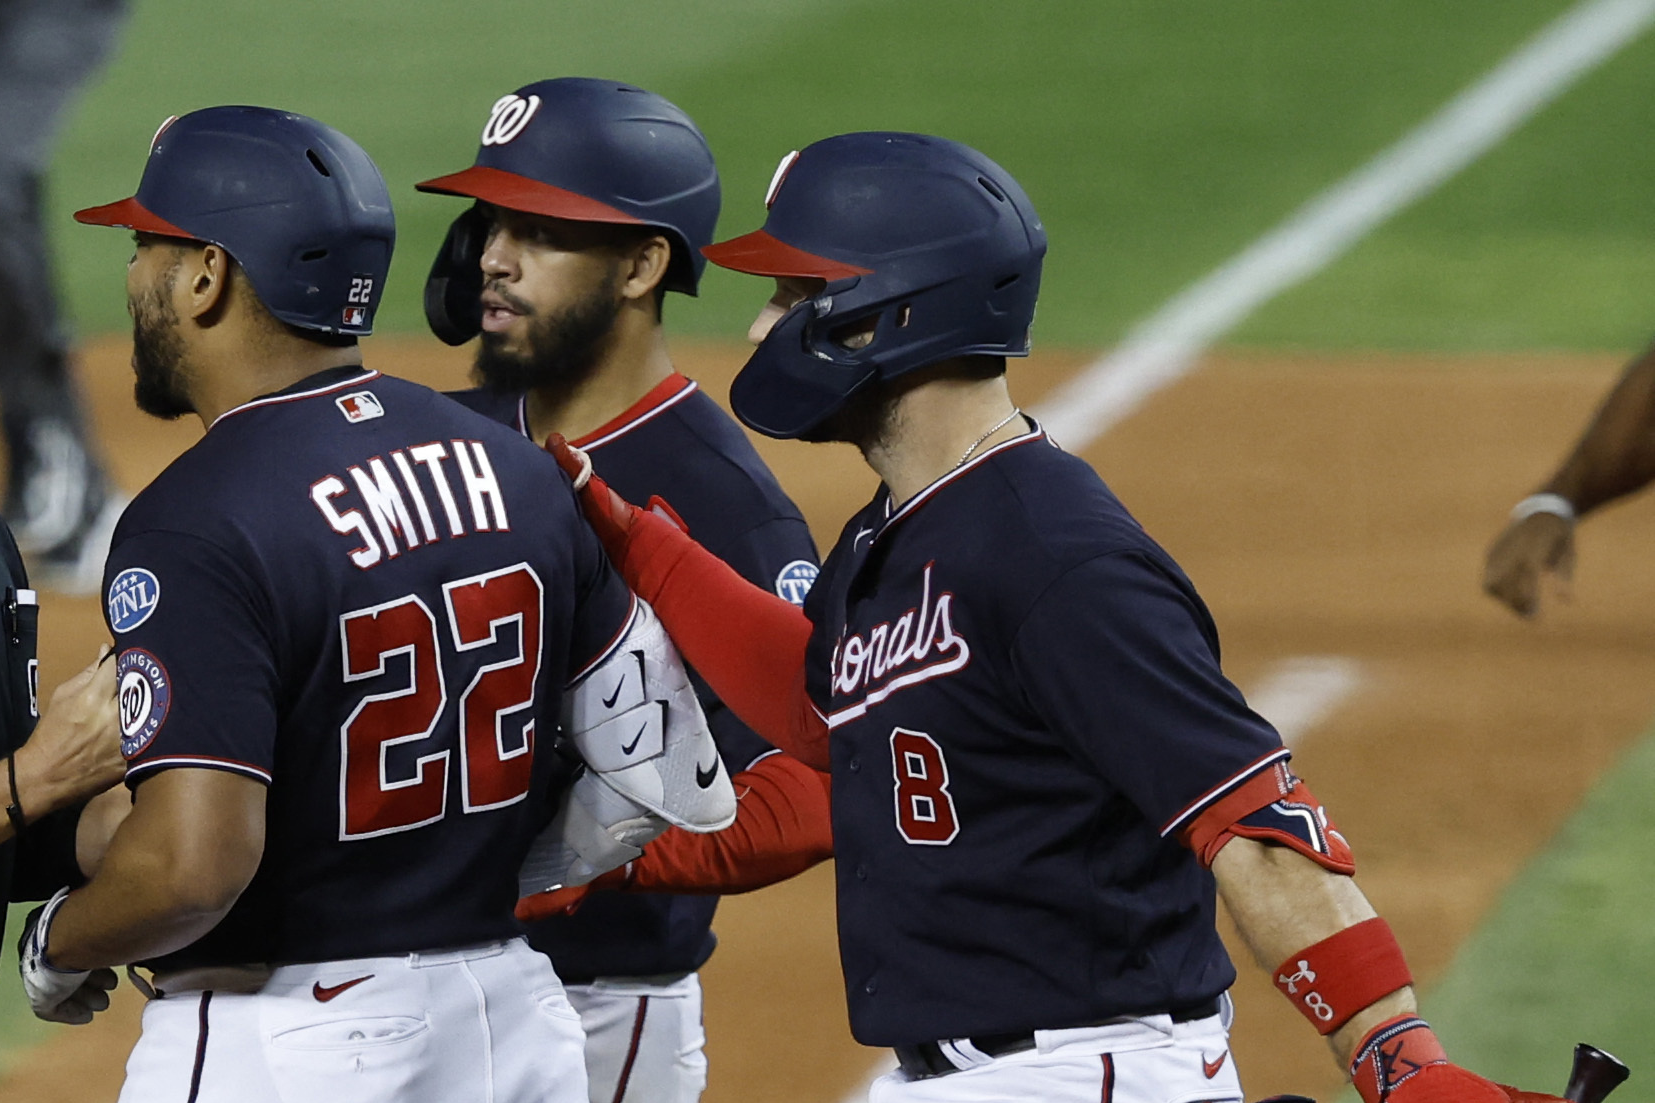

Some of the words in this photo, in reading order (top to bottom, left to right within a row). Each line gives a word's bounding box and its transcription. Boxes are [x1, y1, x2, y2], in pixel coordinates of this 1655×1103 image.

[482, 95, 542, 146] W
[348, 278, 373, 303] 22
[309, 438, 511, 571] SMITH
[110, 581, 155, 625] TNL
[830, 559, 971, 728] onals
[339, 562, 544, 841] 22
[890, 726, 960, 845] 8
[1305, 992, 1333, 1021] 8
